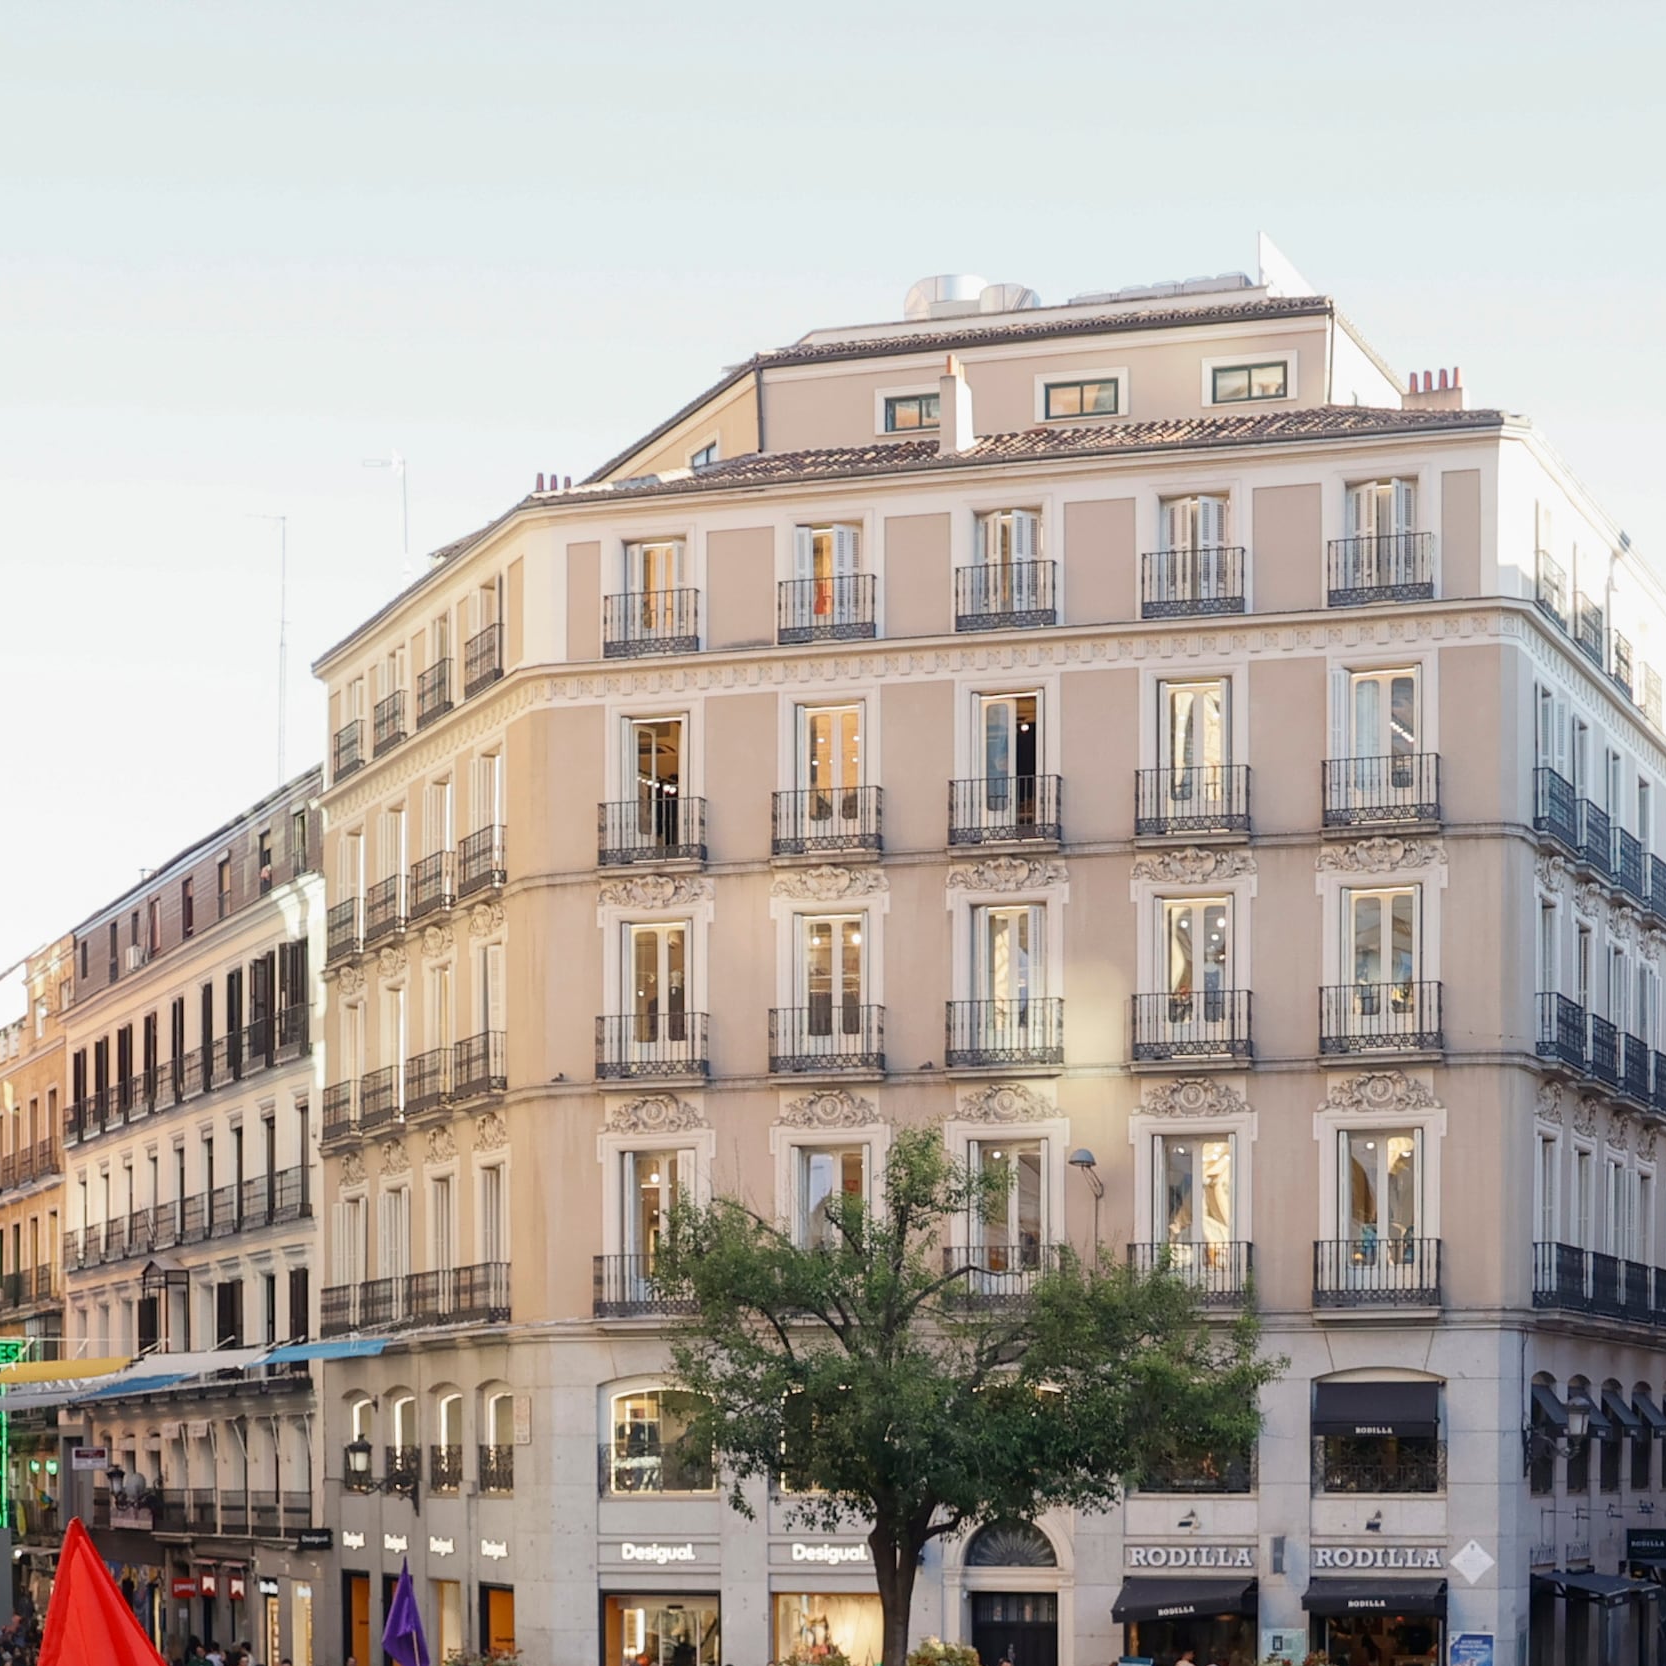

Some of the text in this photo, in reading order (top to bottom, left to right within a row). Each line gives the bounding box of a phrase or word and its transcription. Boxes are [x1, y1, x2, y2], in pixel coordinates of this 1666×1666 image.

[621, 1543, 696, 1564] Desigual.
[791, 1543, 868, 1564] Desigual.
[1130, 1547, 1253, 1567] RODILLA
[1315, 1548, 1443, 1569] RODILLA
[1158, 1605, 1195, 1616] RODILLA
[1347, 1600, 1386, 1608] RODILLA
